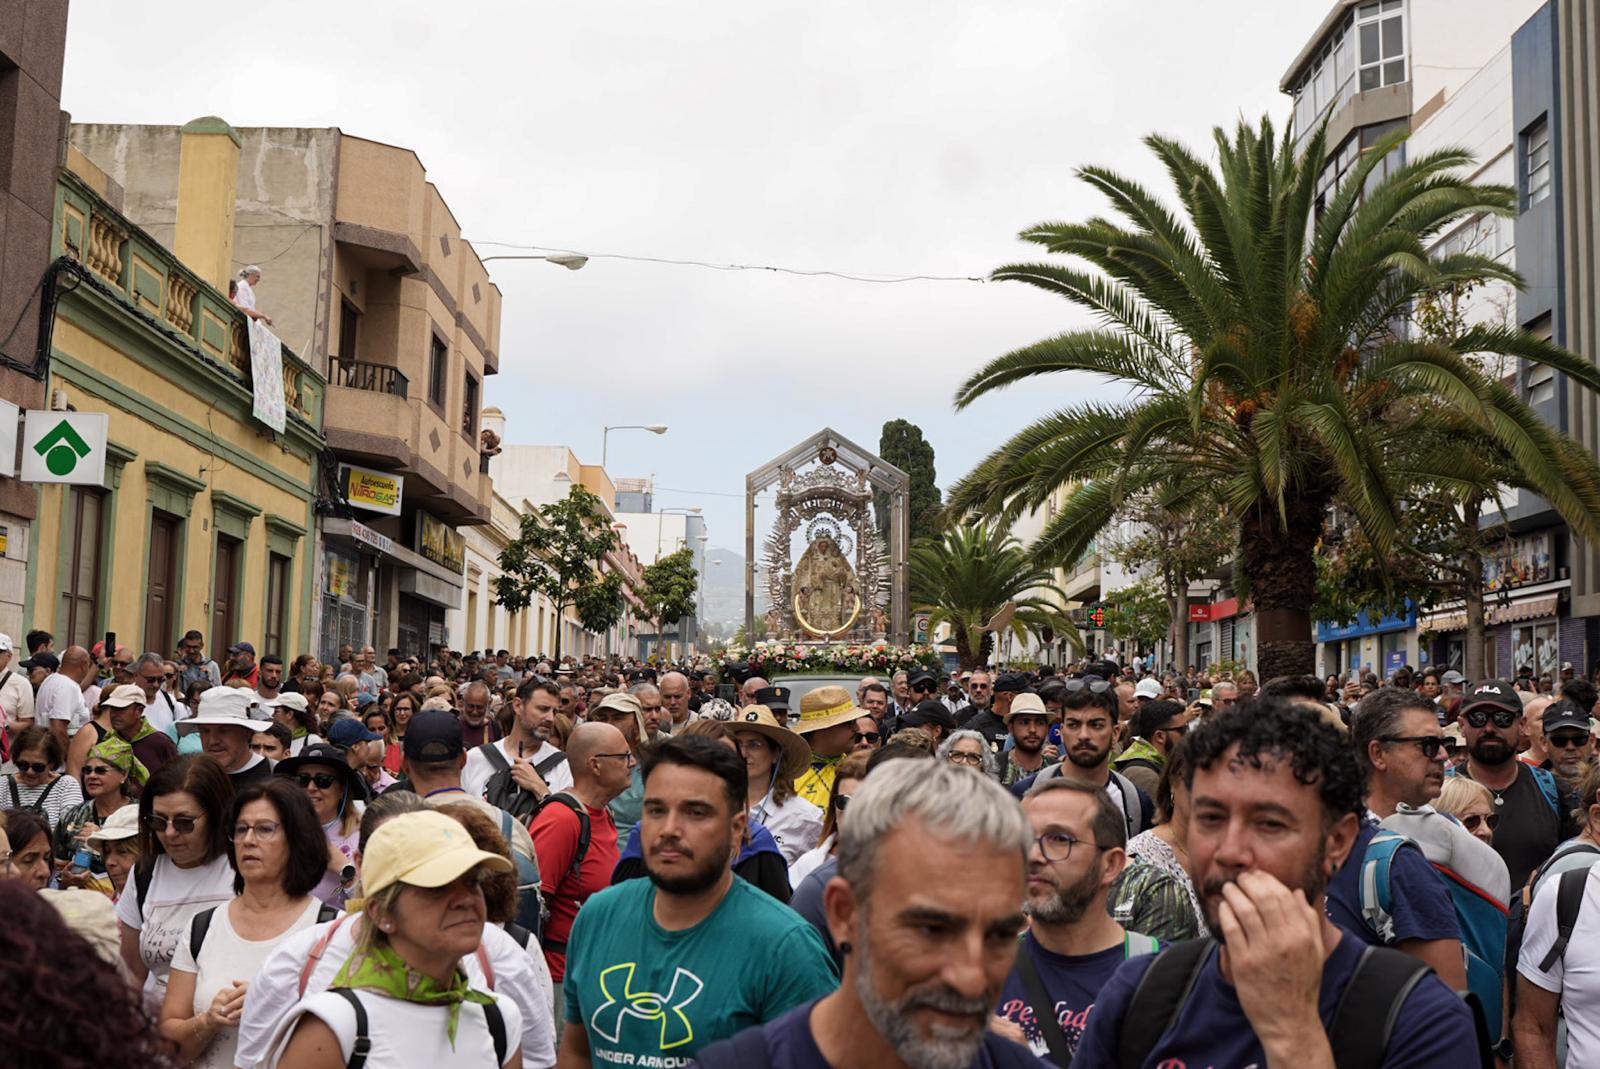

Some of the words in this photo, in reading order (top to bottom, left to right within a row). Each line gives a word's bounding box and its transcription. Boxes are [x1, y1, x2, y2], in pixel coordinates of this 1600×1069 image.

[361, 475, 394, 490] Autoescuela
[1474, 685, 1501, 695] FILA
[595, 1047, 635, 1065] UNDER
